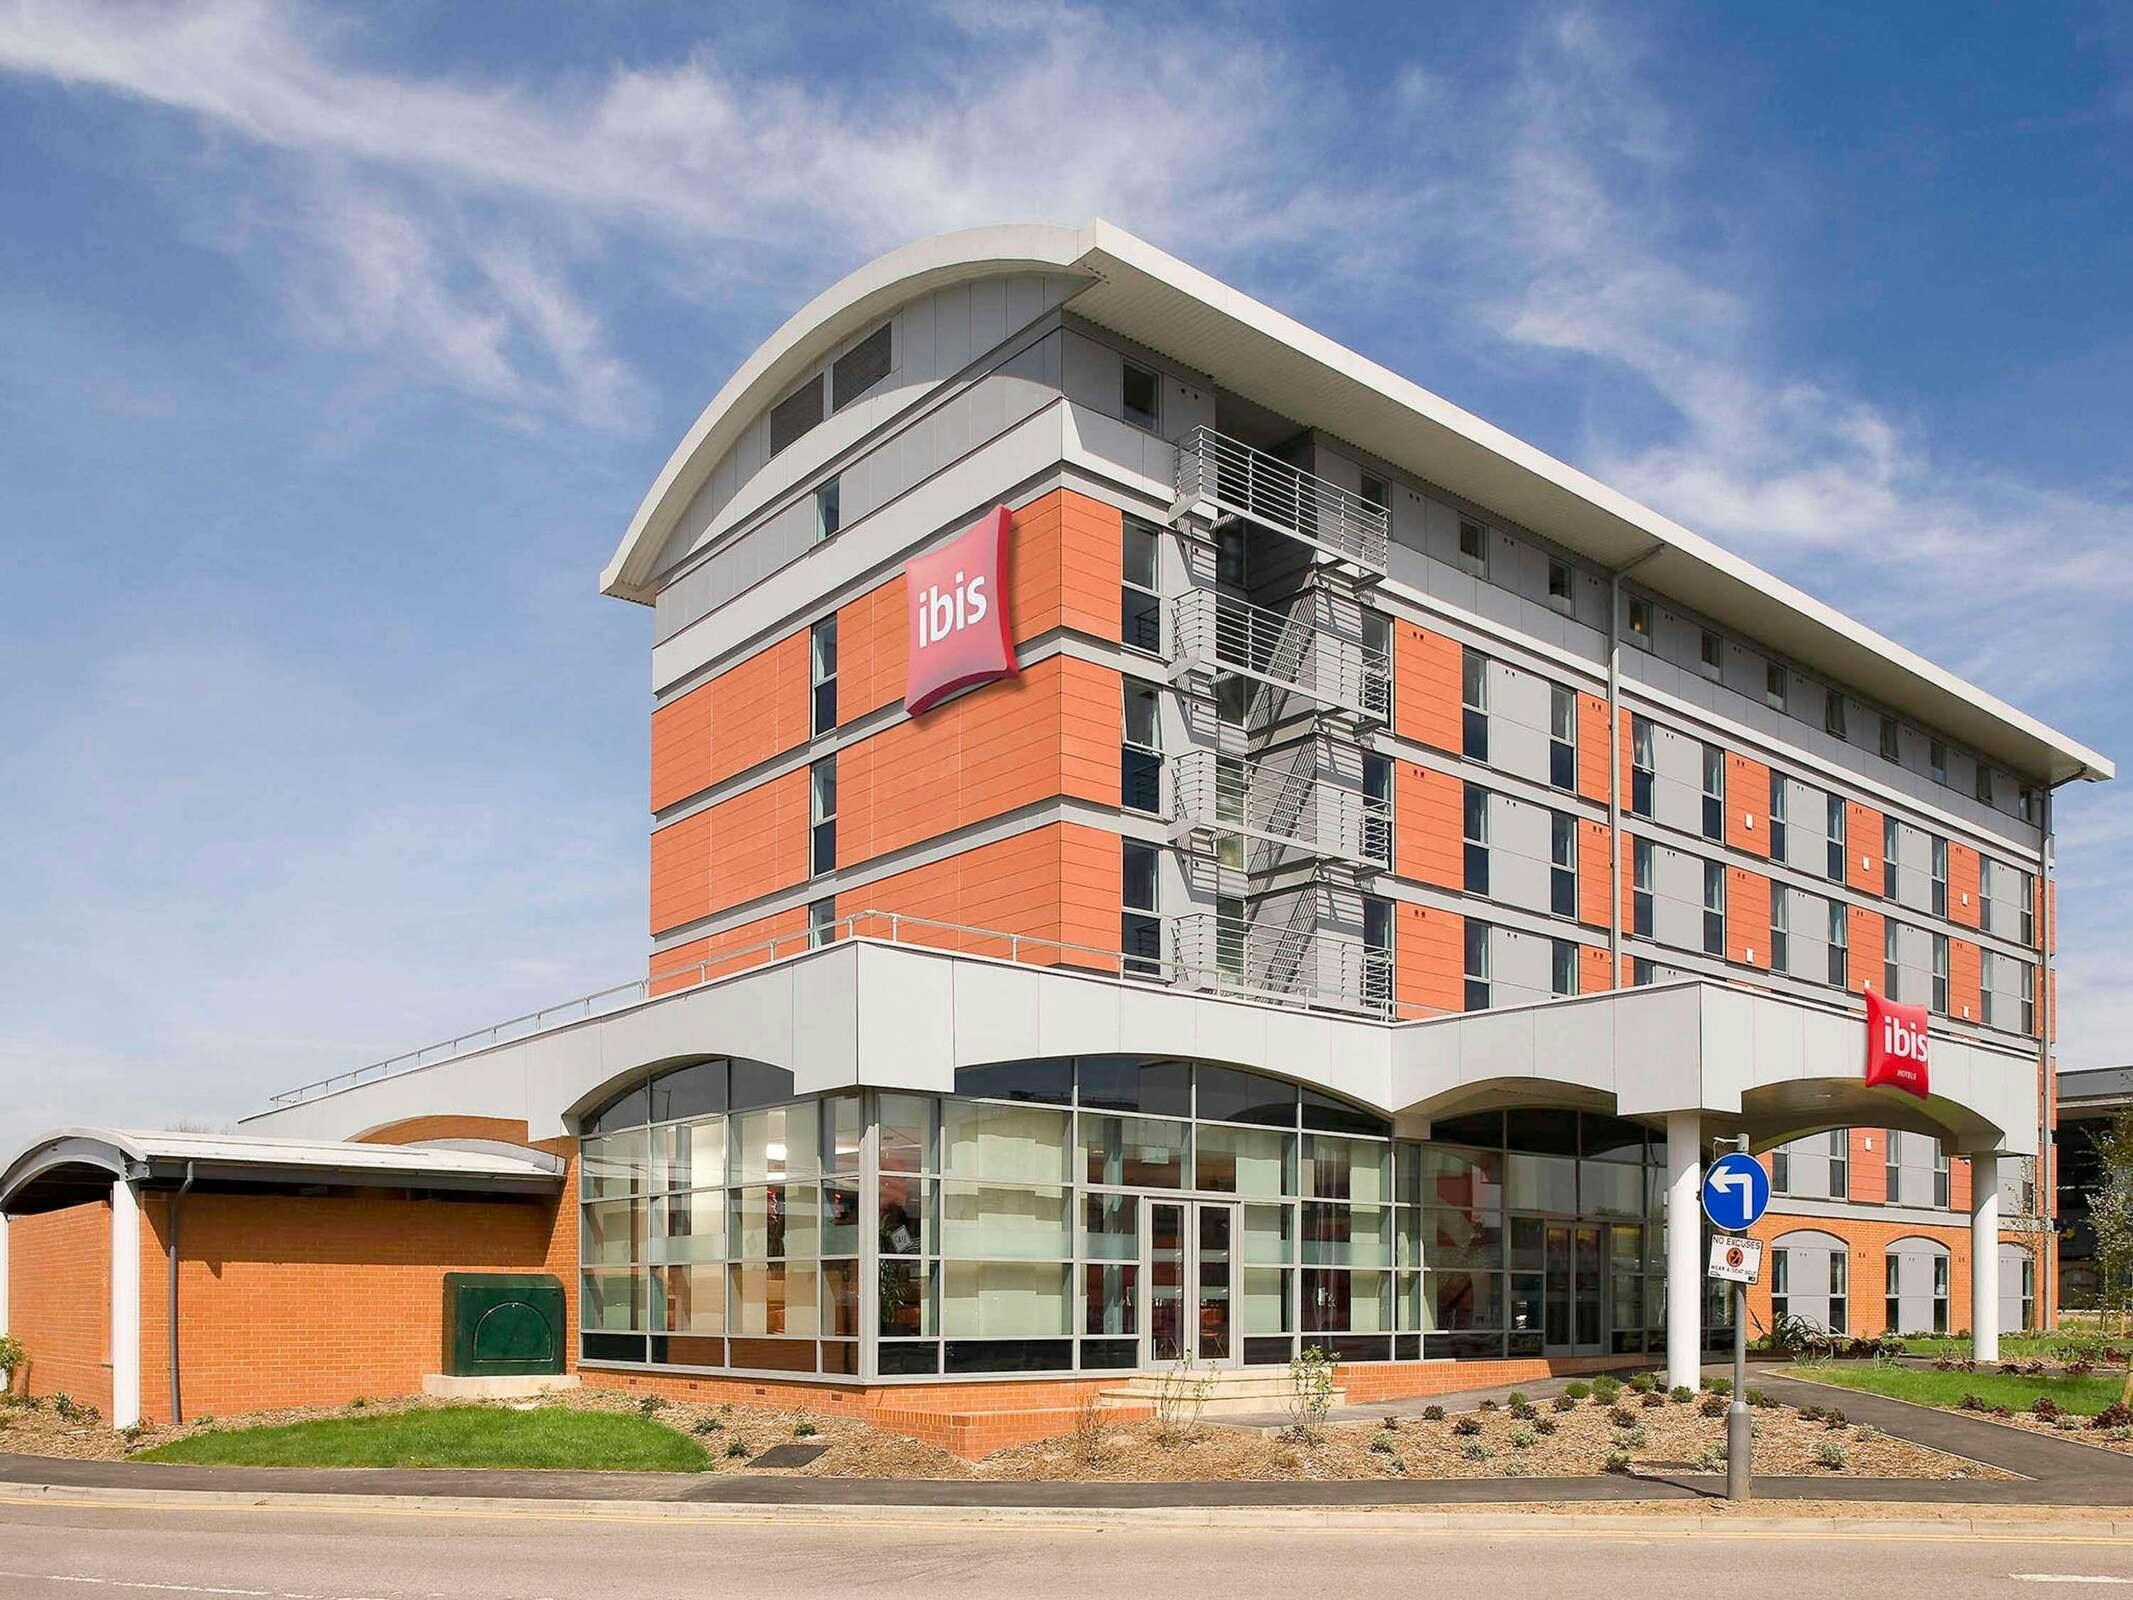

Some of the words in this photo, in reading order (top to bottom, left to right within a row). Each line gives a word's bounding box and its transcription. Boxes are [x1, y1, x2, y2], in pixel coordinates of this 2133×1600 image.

[919, 571, 987, 648] ibis
[1884, 1015, 1928, 1062] ibis
[1713, 1236, 1724, 1245] NO
[1727, 1238, 1760, 1249] EXCUSES
